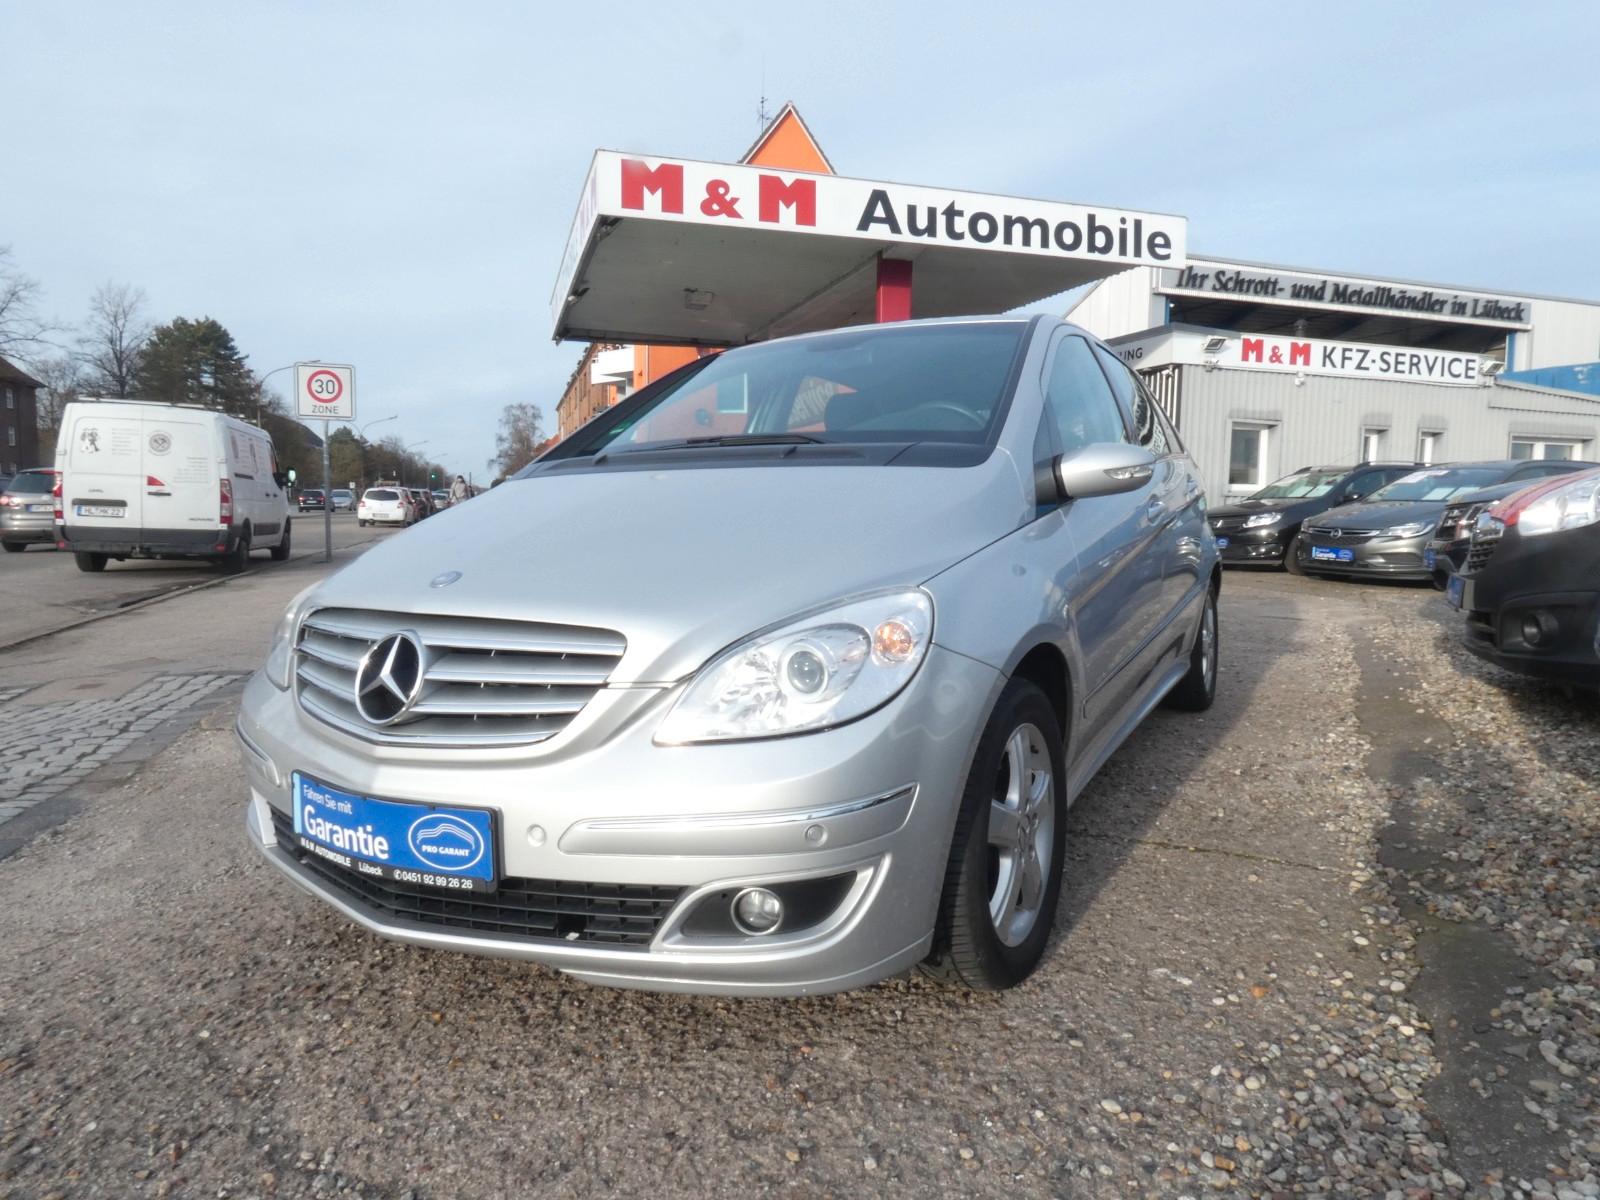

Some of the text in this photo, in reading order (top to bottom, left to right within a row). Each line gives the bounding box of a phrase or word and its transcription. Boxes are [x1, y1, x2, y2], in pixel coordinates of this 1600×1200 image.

[621, 158, 1173, 261] M & M Automobile
[1176, 266, 1525, 321] Ihr Schrott- und Metallhändler in Lübeck
[1117, 347, 1144, 361] ING
[1241, 337, 1264, 363] M
[1268, 345, 1284, 364] &
[1289, 341, 1312, 366] M
[314, 378, 336, 394] 30
[312, 404, 339, 414] ZONE
[304, 785, 353, 815] Fahren Sie mit
[304, 804, 390, 860] Garantie
[315, 846, 351, 866] AUTOMOBILE
[358, 861, 383, 876] Lübeck
[421, 844, 470, 857] PRO GARANT
[402, 871, 473, 889] 0451 92 99 26 26
